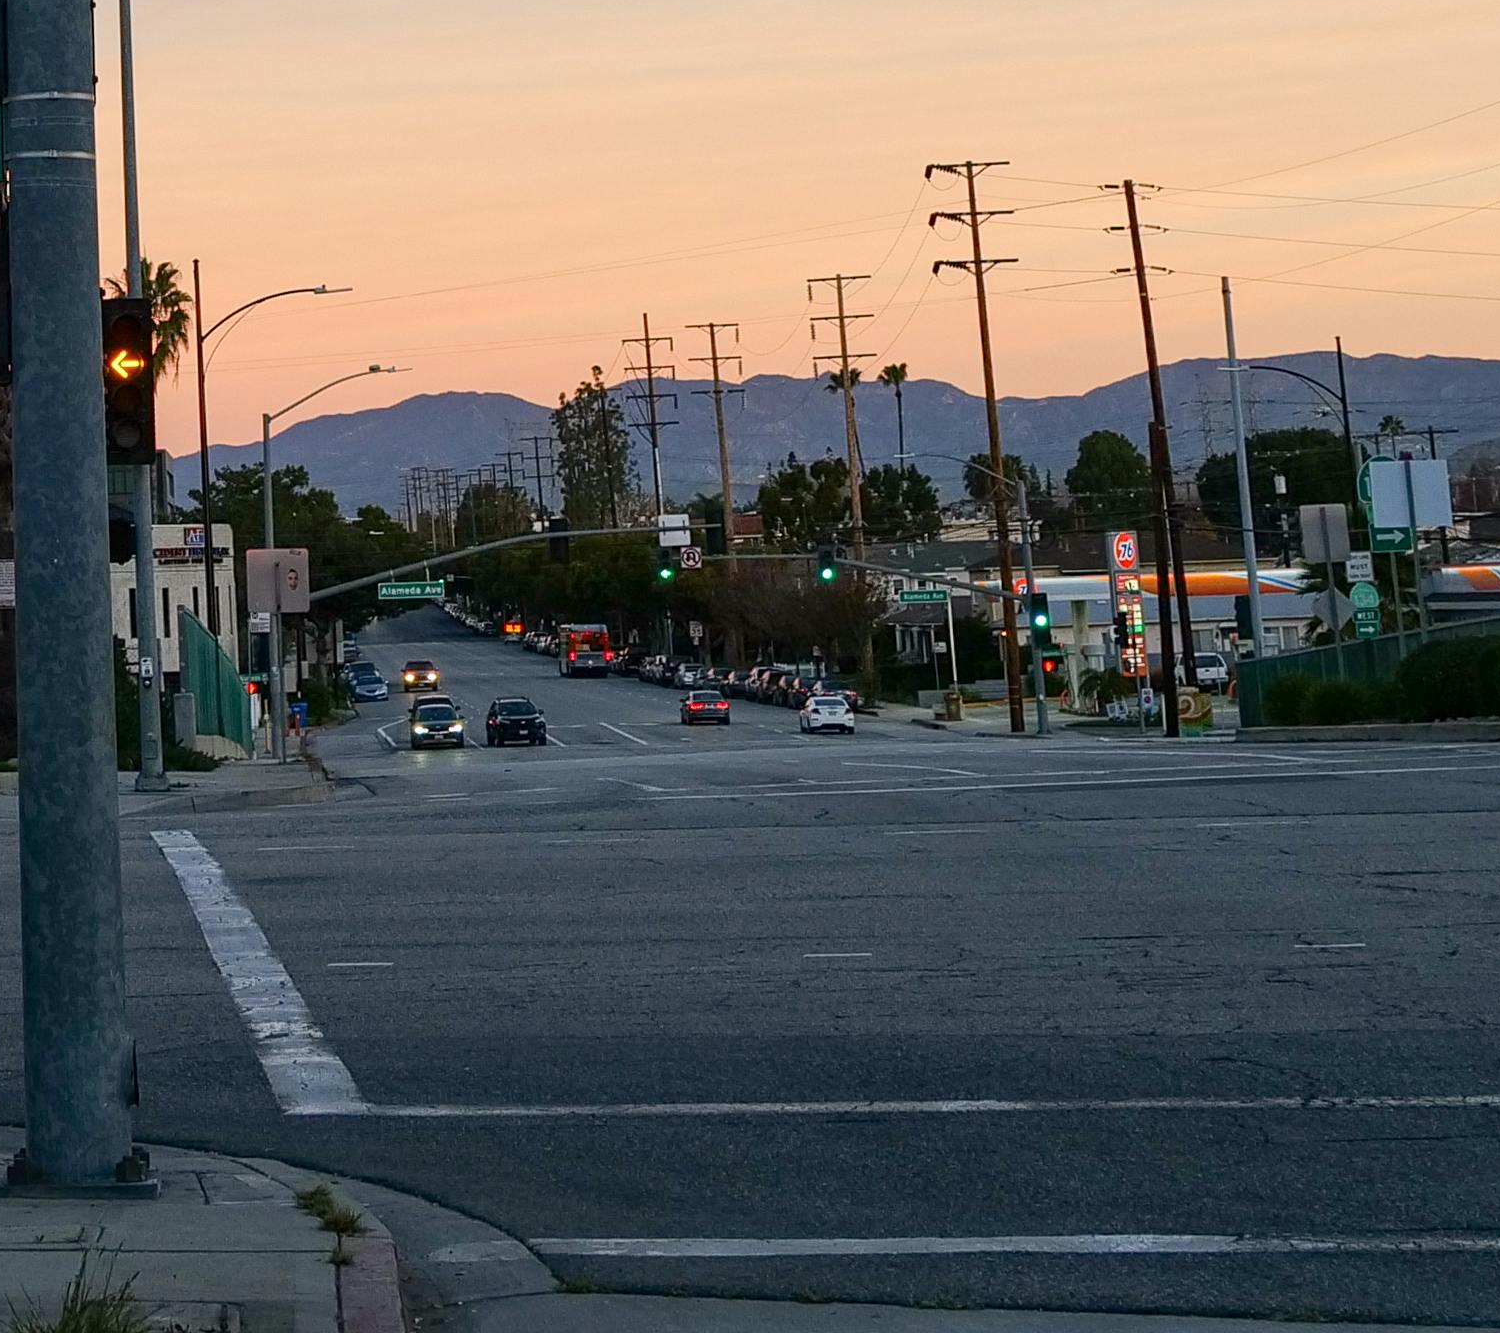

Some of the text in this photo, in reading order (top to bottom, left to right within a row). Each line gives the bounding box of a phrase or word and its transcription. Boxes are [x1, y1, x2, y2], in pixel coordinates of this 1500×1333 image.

[1119, 540, 1135, 561] 76
[381, 585, 442, 595] Alameda Ave
